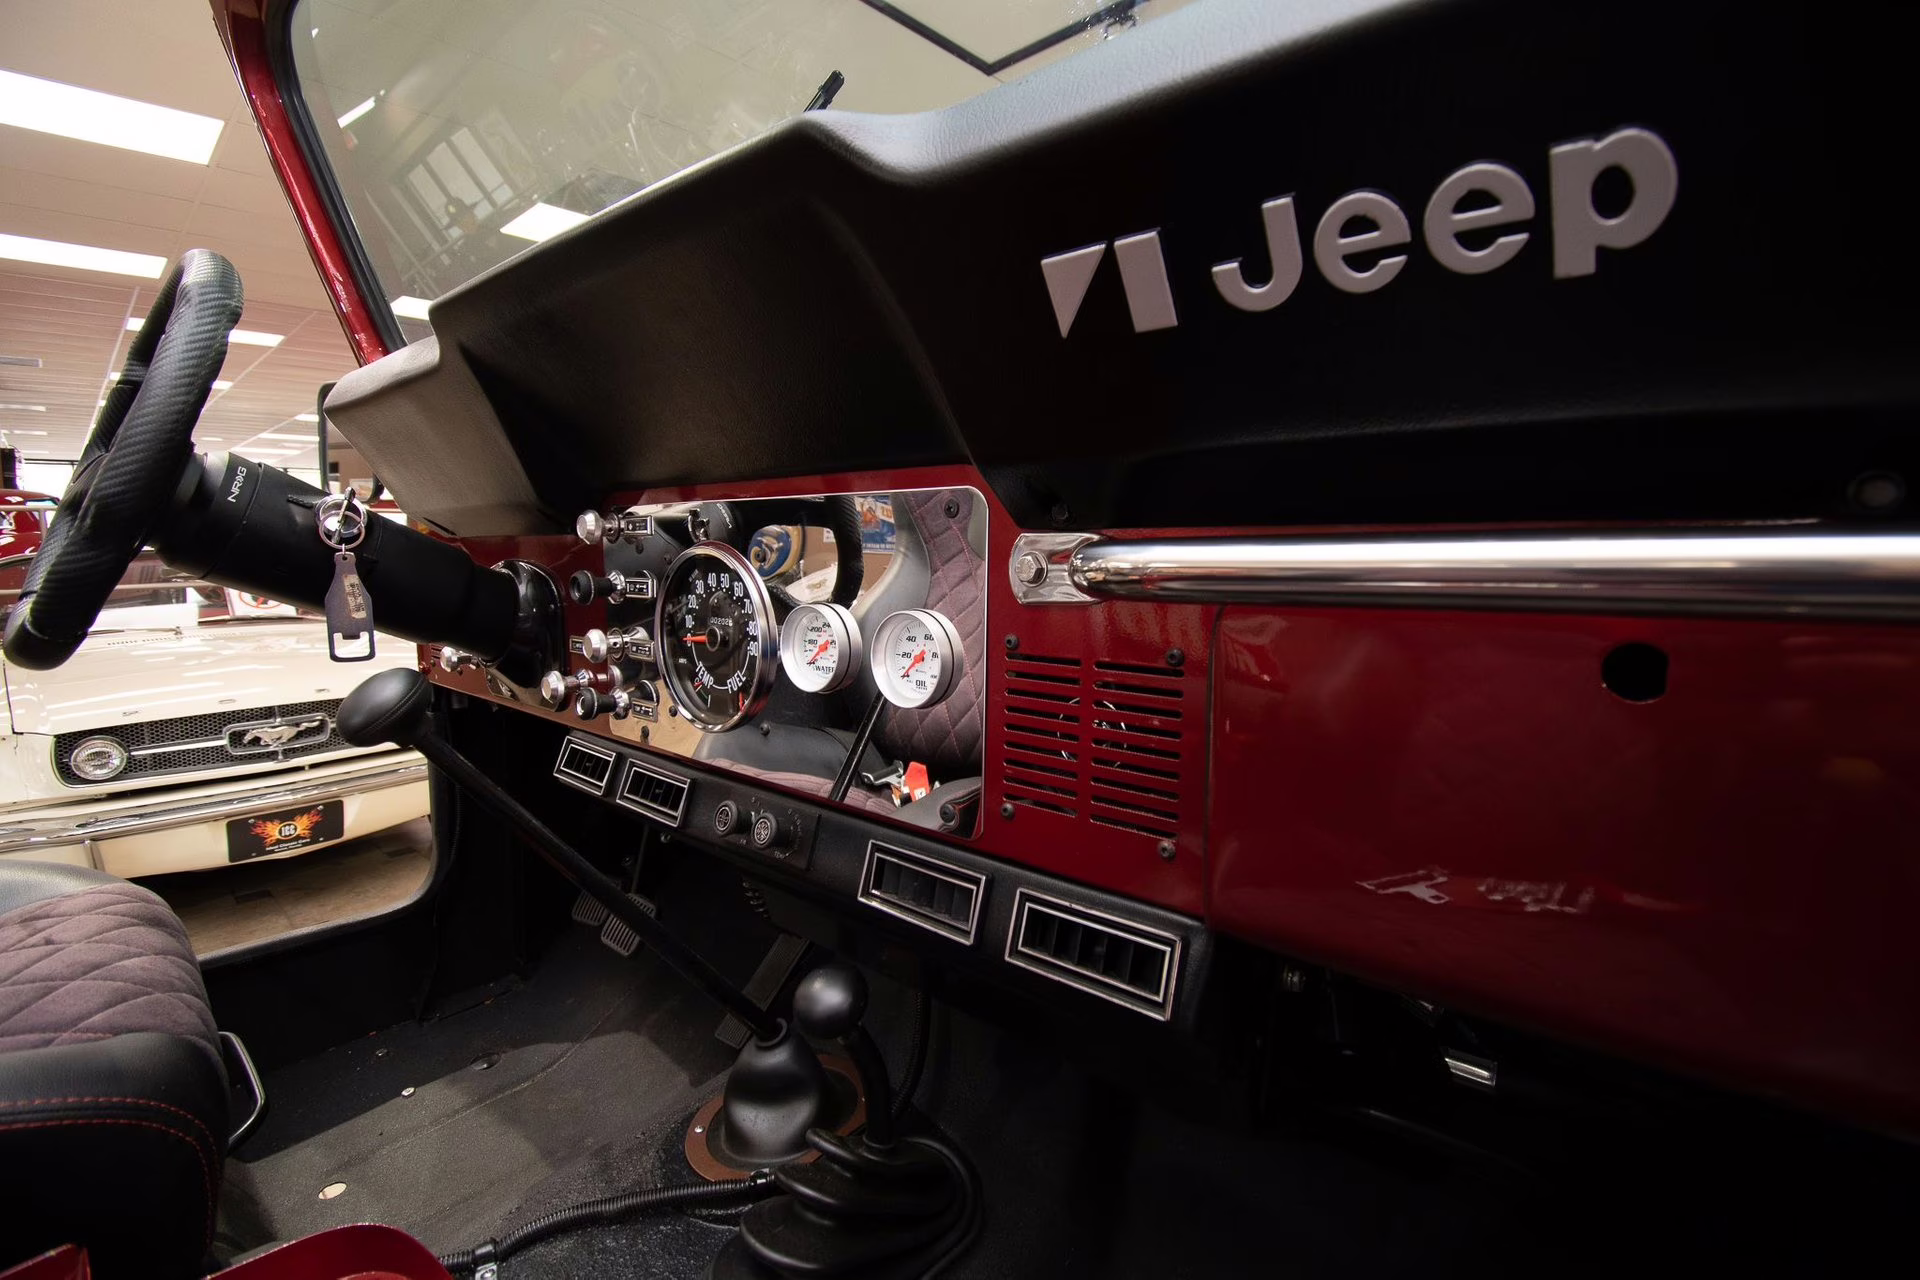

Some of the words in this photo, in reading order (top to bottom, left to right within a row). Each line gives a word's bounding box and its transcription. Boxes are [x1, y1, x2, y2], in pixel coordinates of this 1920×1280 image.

[1211, 126, 1679, 312] Jeep
[695, 579, 704, 594] 30
[707, 573, 717, 588] 40
[720, 573, 730, 588] 50
[733, 582, 744, 597] 60
[688, 594, 697, 609] 20
[743, 599, 753, 614] 70
[685, 615, 693, 628] 10
[748, 621, 758, 636] 80
[905, 635, 917, 643] 40
[749, 641, 758, 656] 90
[901, 651, 912, 659] 20
[695, 661, 714, 689] TEMP
[726, 670, 747, 694] FUEL
[915, 679, 928, 687] OIL
